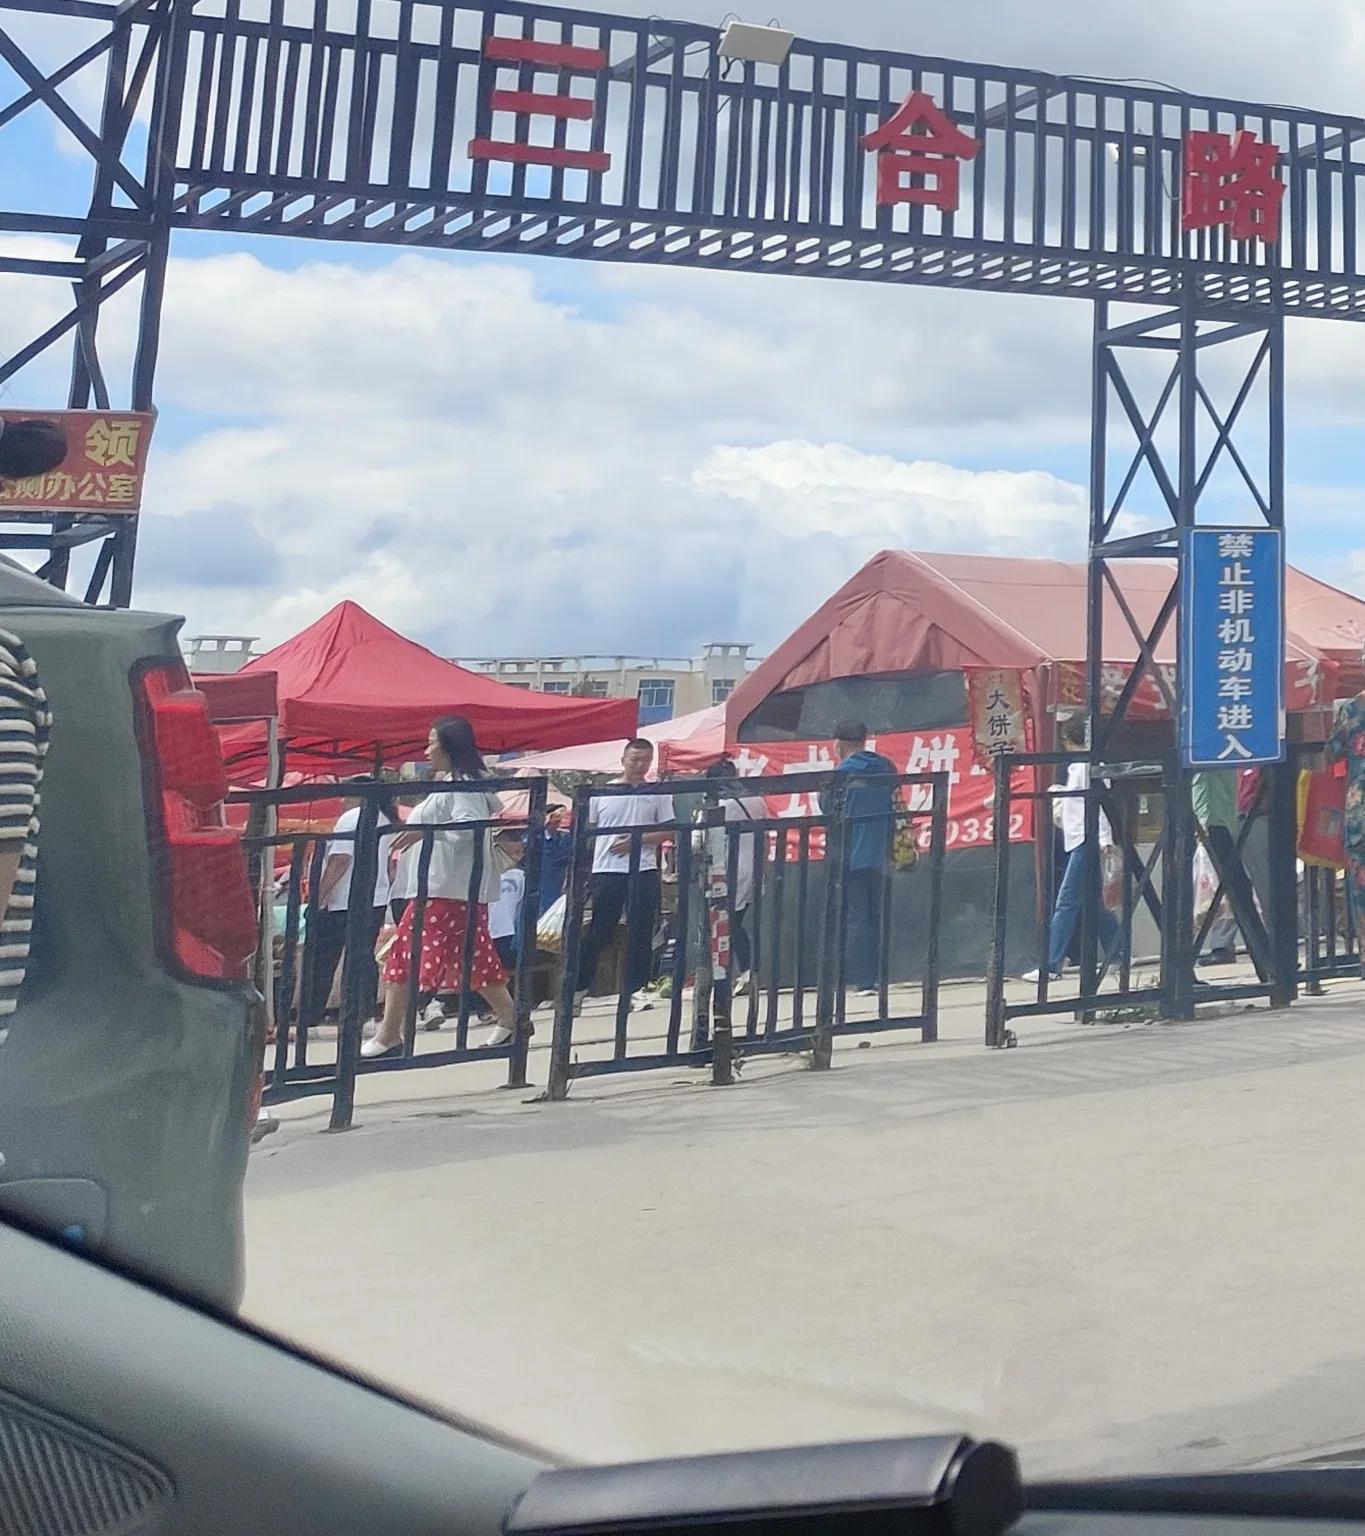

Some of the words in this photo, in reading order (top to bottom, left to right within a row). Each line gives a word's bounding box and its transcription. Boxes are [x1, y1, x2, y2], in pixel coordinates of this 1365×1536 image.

[1217, 533, 1255, 760] 禁止非机动车进入
